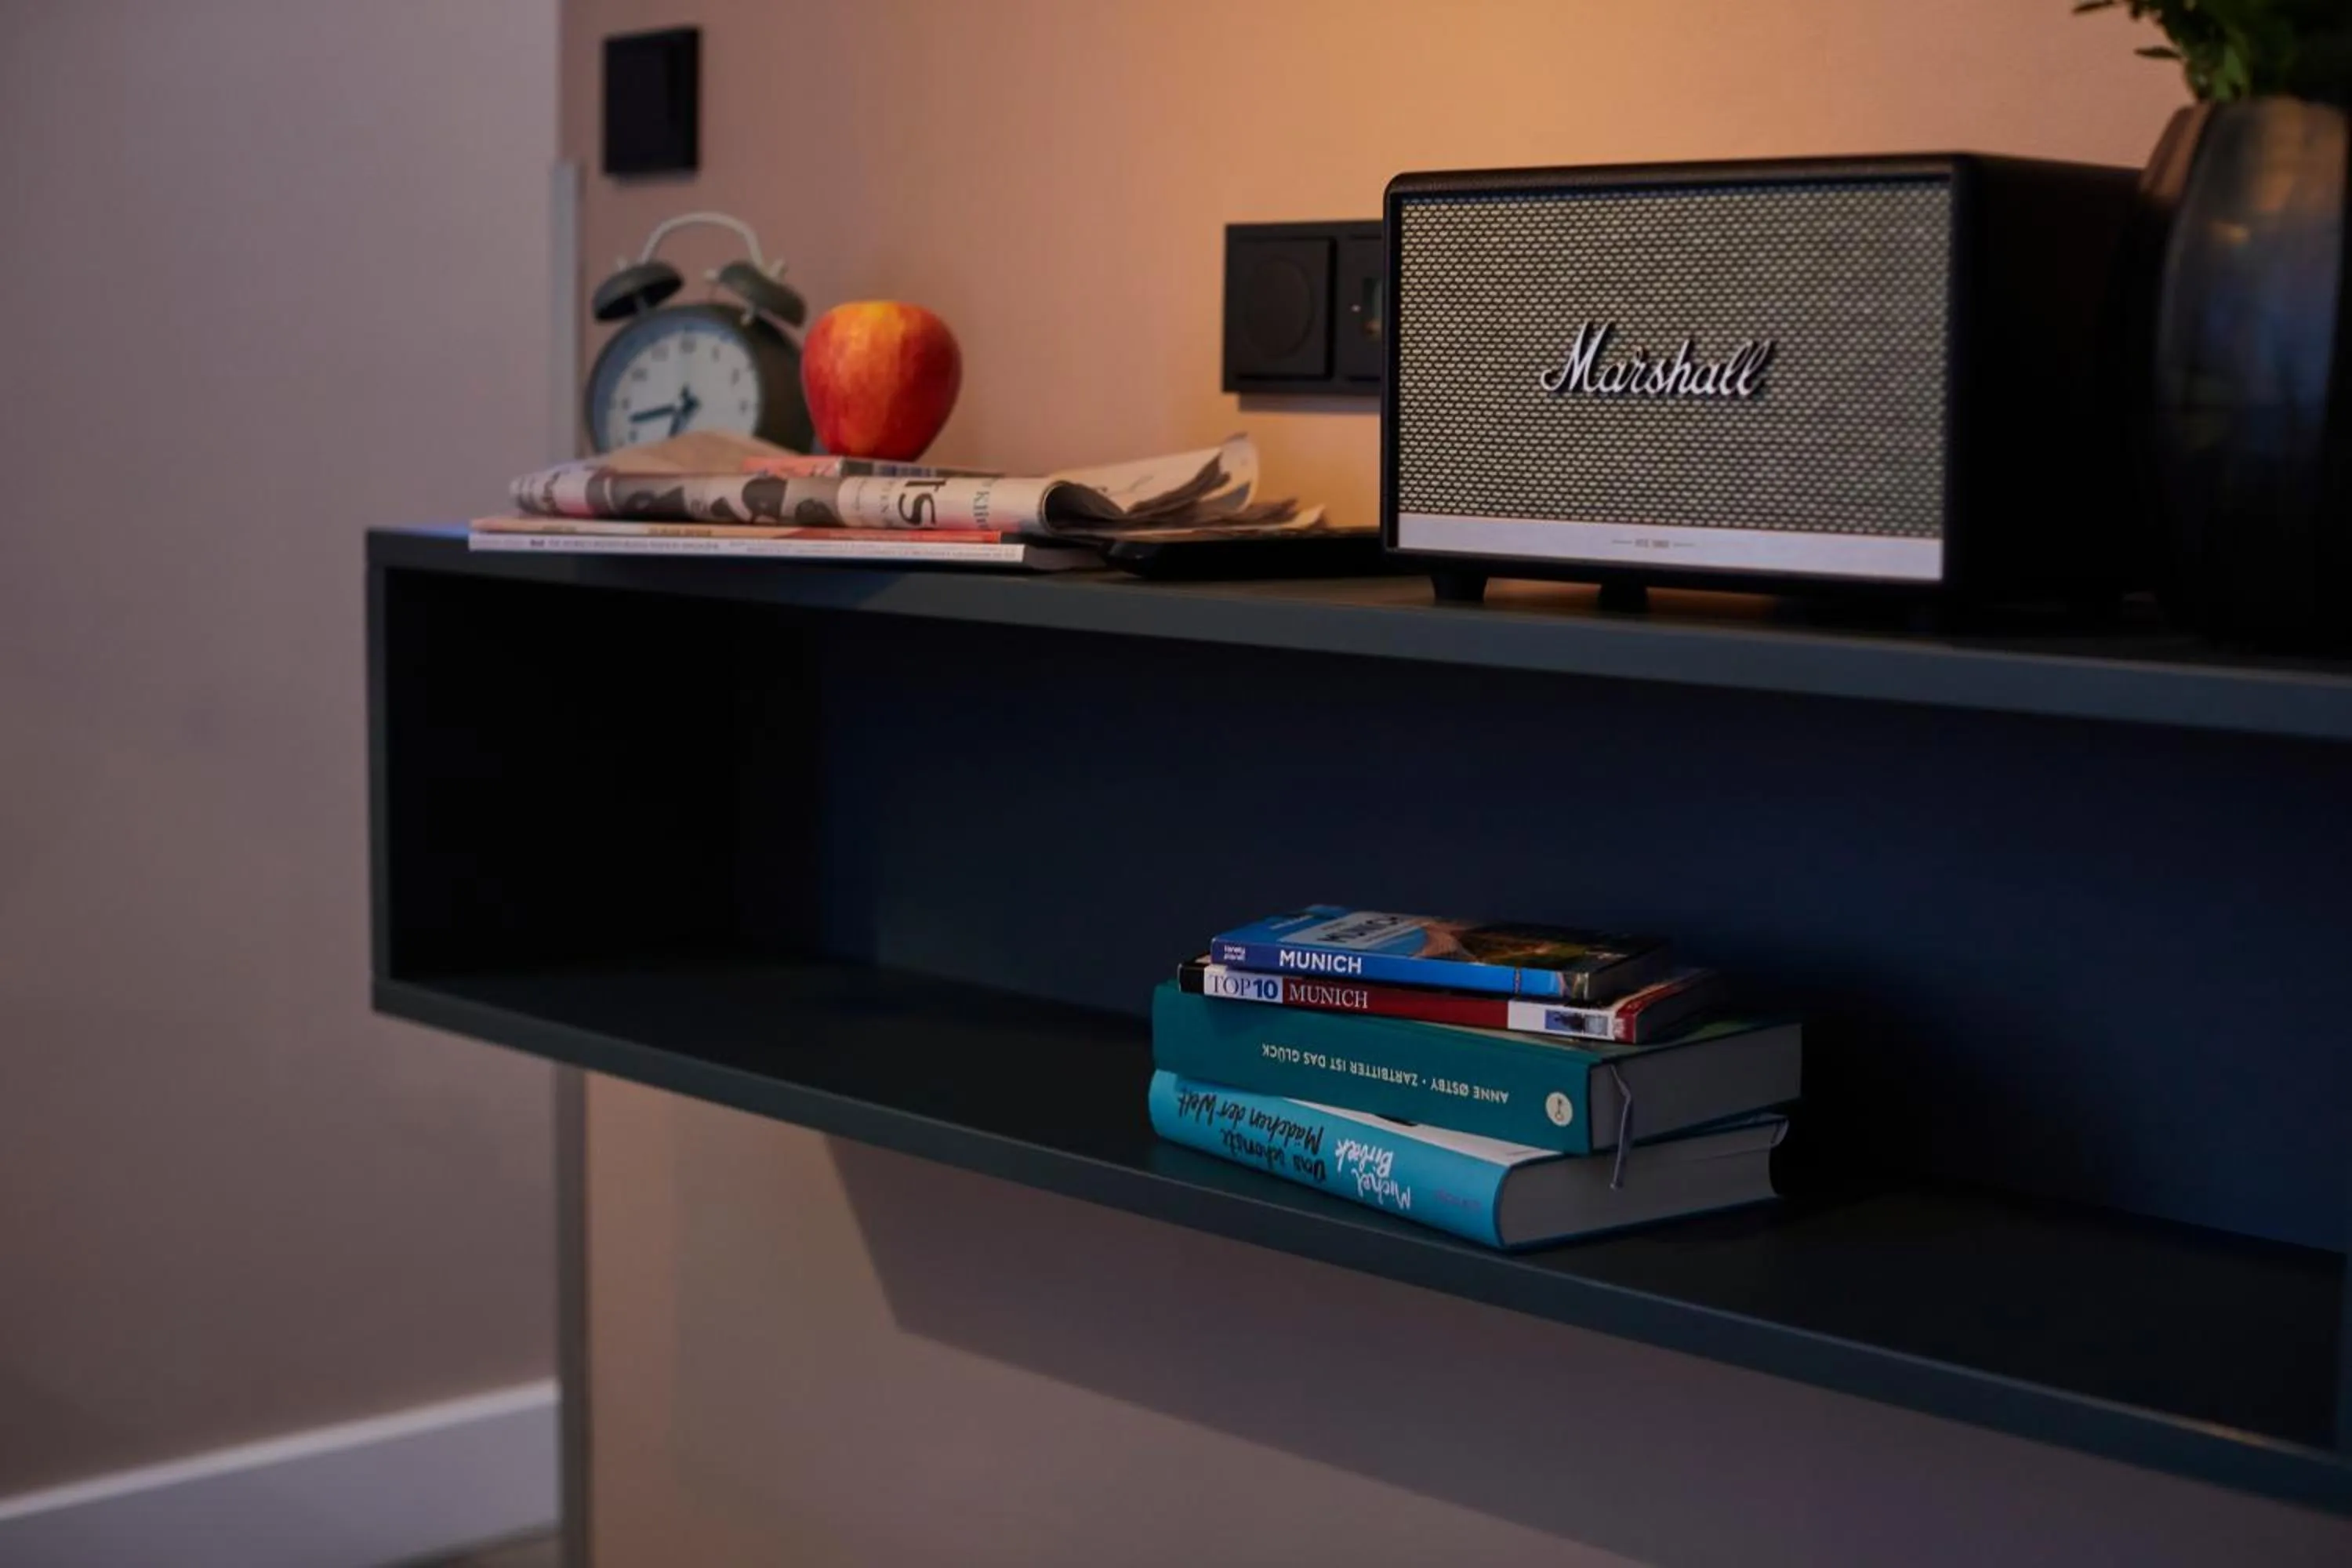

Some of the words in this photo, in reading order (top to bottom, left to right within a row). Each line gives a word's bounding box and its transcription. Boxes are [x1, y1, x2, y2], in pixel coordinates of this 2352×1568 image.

[1540, 320, 1773, 395] Marshall
[1279, 949, 1362, 975] MUNICH
[1288, 982, 1369, 1009] MUNICH
[1261, 1044, 1300, 1063] GLÜCK
[1303, 1051, 1326, 1068] DAS
[1329, 1058, 1346, 1072] IST
[1350, 1061, 1418, 1086] ZARTBITTER
[1430, 1077, 1469, 1097] ØSTBY
[1472, 1086, 1509, 1104] ANNE
[1178, 1086, 1218, 1126] Welt
[1218, 1100, 1247, 1127] der
[1249, 1106, 1325, 1156] Mädchen
[1354, 1167, 1411, 1210] Michel
